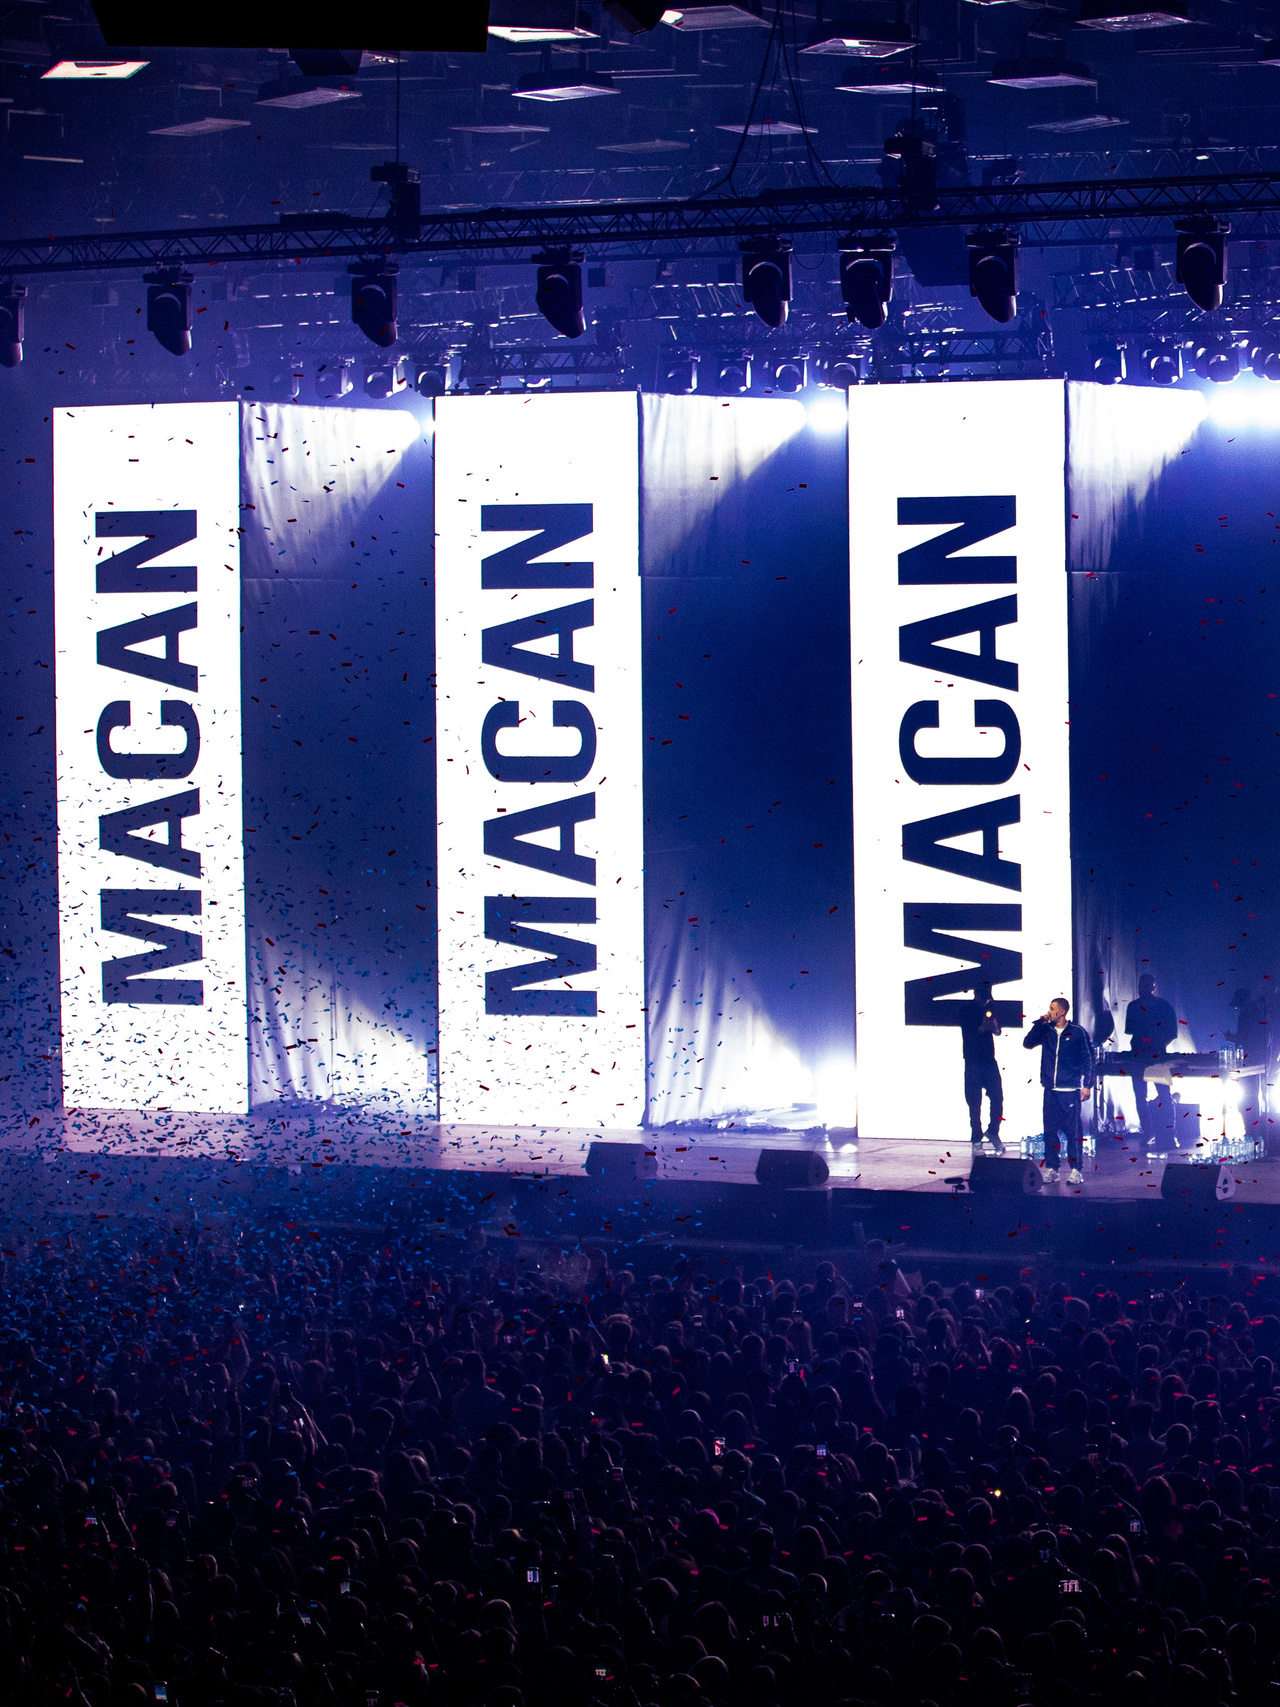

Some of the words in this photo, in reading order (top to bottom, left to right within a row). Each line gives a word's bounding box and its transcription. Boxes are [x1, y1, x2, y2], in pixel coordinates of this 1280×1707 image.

[96, 510, 204, 1005] MACAN
[481, 504, 597, 1017] MACAN
[897, 495, 1023, 1027] MACAN
